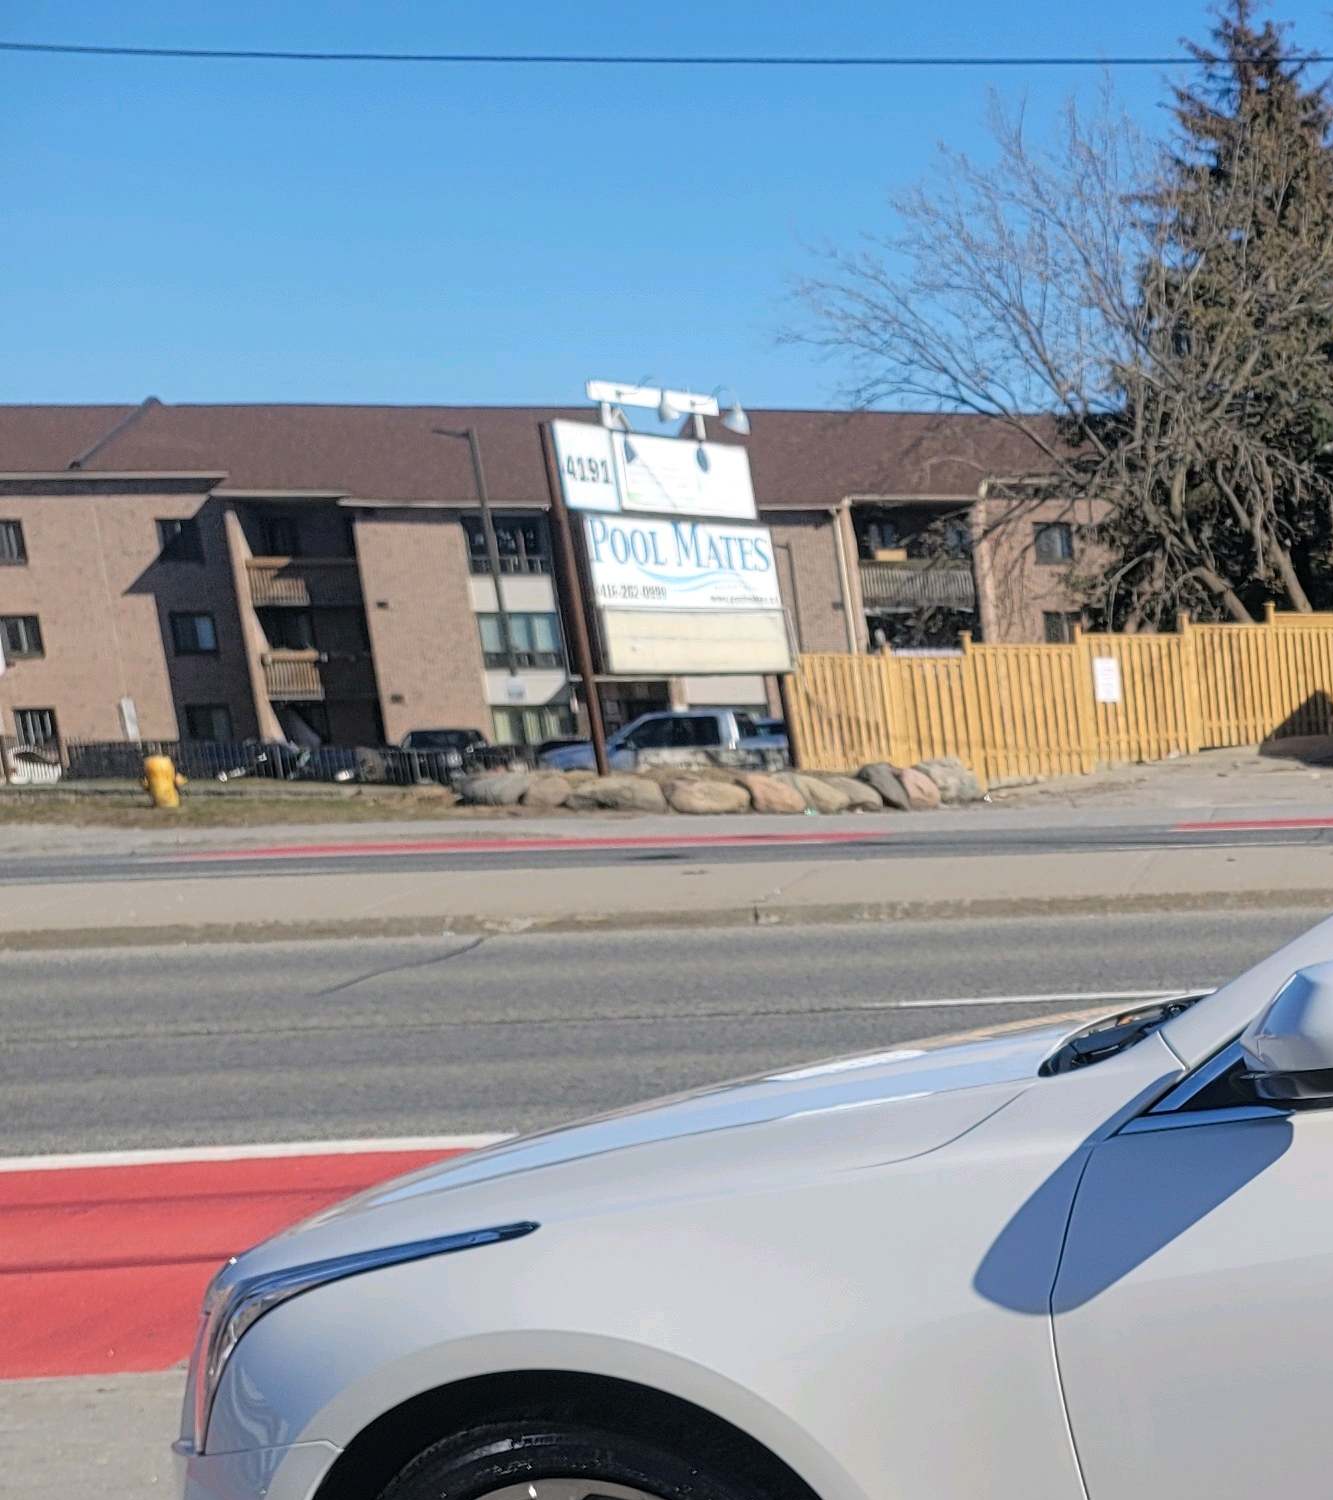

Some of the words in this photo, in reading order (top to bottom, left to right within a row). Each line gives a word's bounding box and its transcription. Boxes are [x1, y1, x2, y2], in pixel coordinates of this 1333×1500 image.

[566, 455, 613, 483] 4191
[588, 516, 668, 567] POOL
[670, 519, 772, 573] MATES
